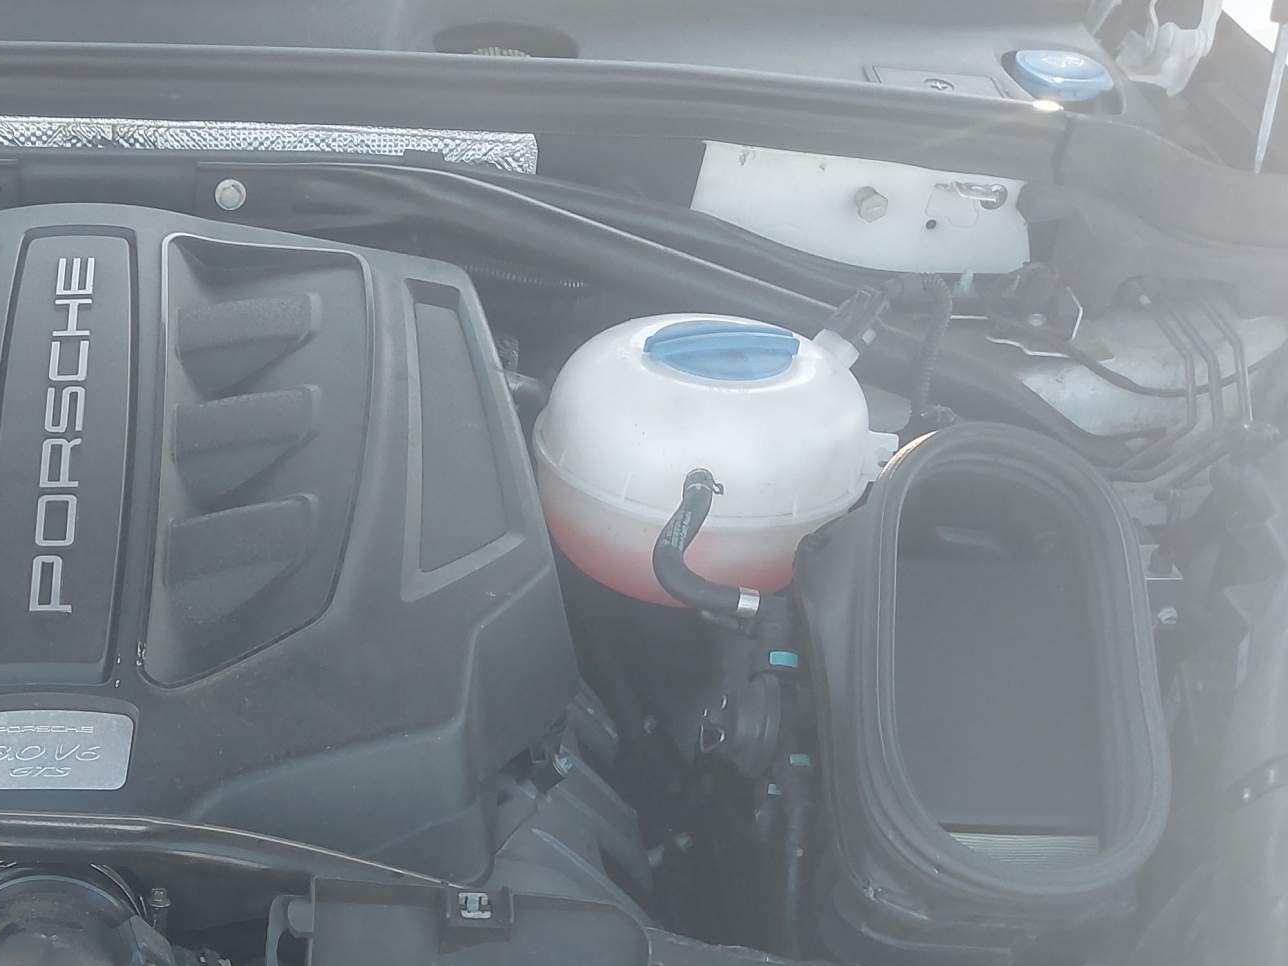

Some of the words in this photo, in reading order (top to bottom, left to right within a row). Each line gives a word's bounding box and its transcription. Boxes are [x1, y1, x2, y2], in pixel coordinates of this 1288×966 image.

[29, 257, 95, 614] PORSCHE
[54, 743, 102, 761] V6
[9, 766, 72, 777] GTS
